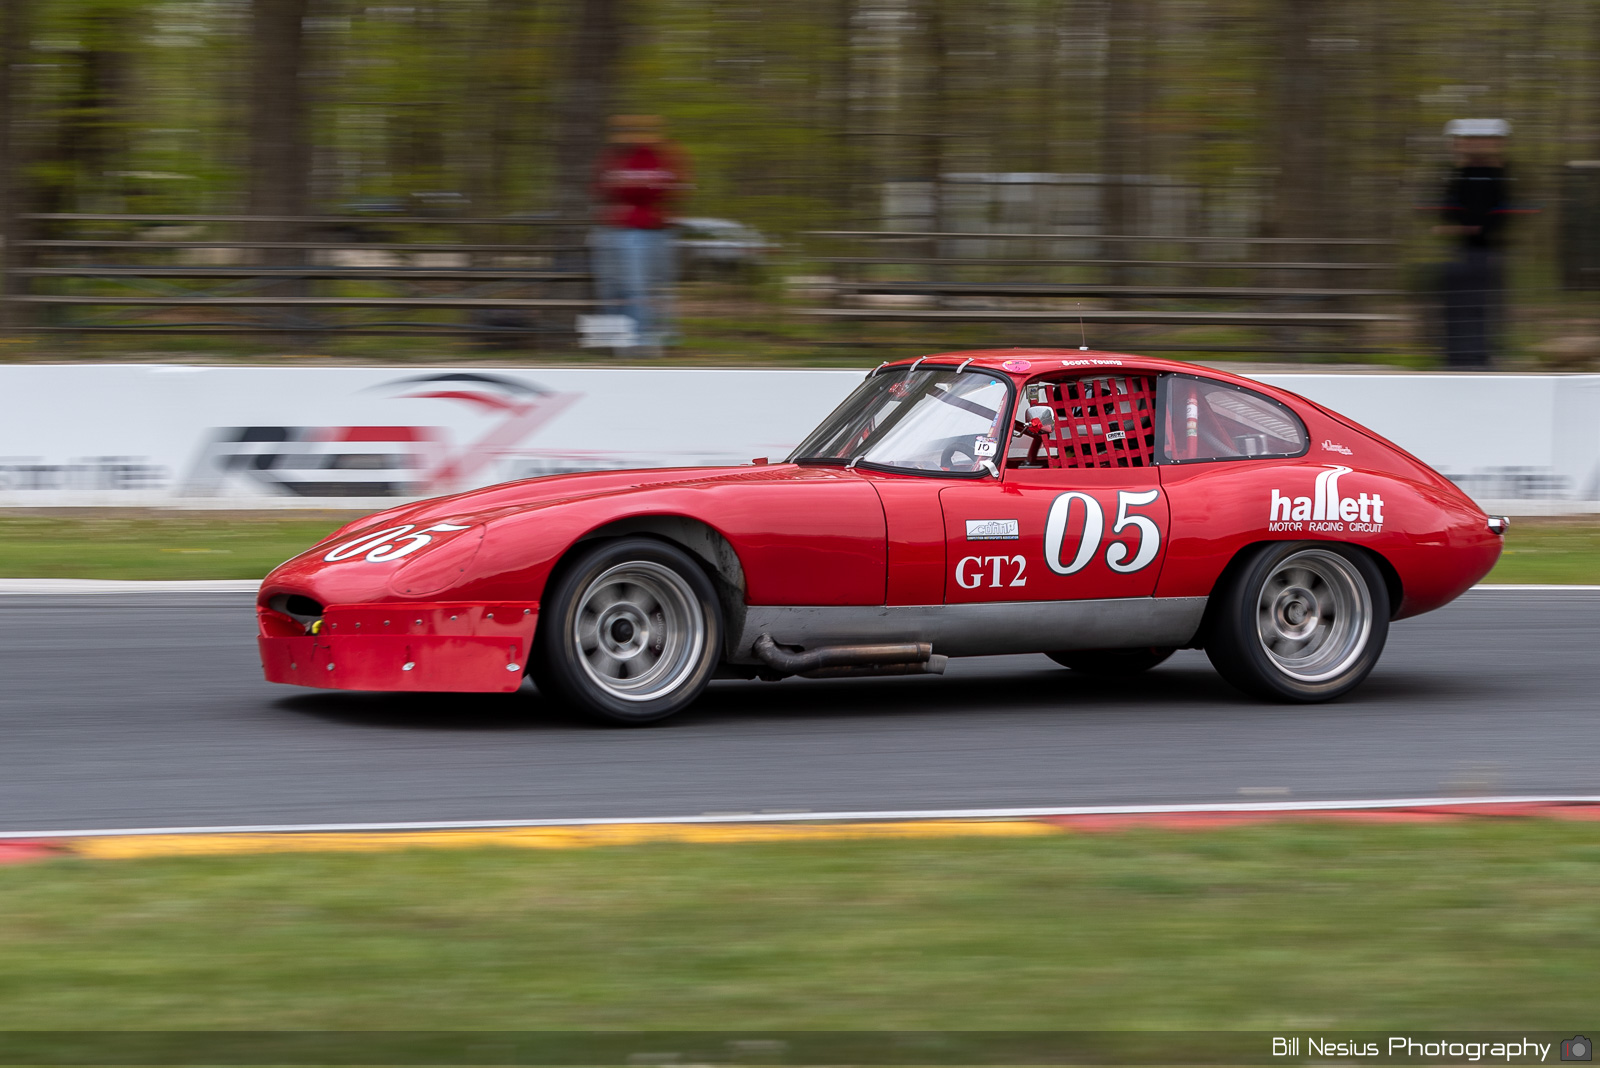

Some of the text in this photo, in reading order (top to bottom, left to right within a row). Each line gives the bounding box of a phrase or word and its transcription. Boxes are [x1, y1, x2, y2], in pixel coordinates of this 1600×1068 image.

[1269, 464, 1384, 523] hallett
[323, 523, 472, 563] 05
[1043, 489, 1162, 577] 05
[1268, 522, 1384, 533] MOTOR RACING CIRCUIT
[955, 554, 1027, 589] GT2
